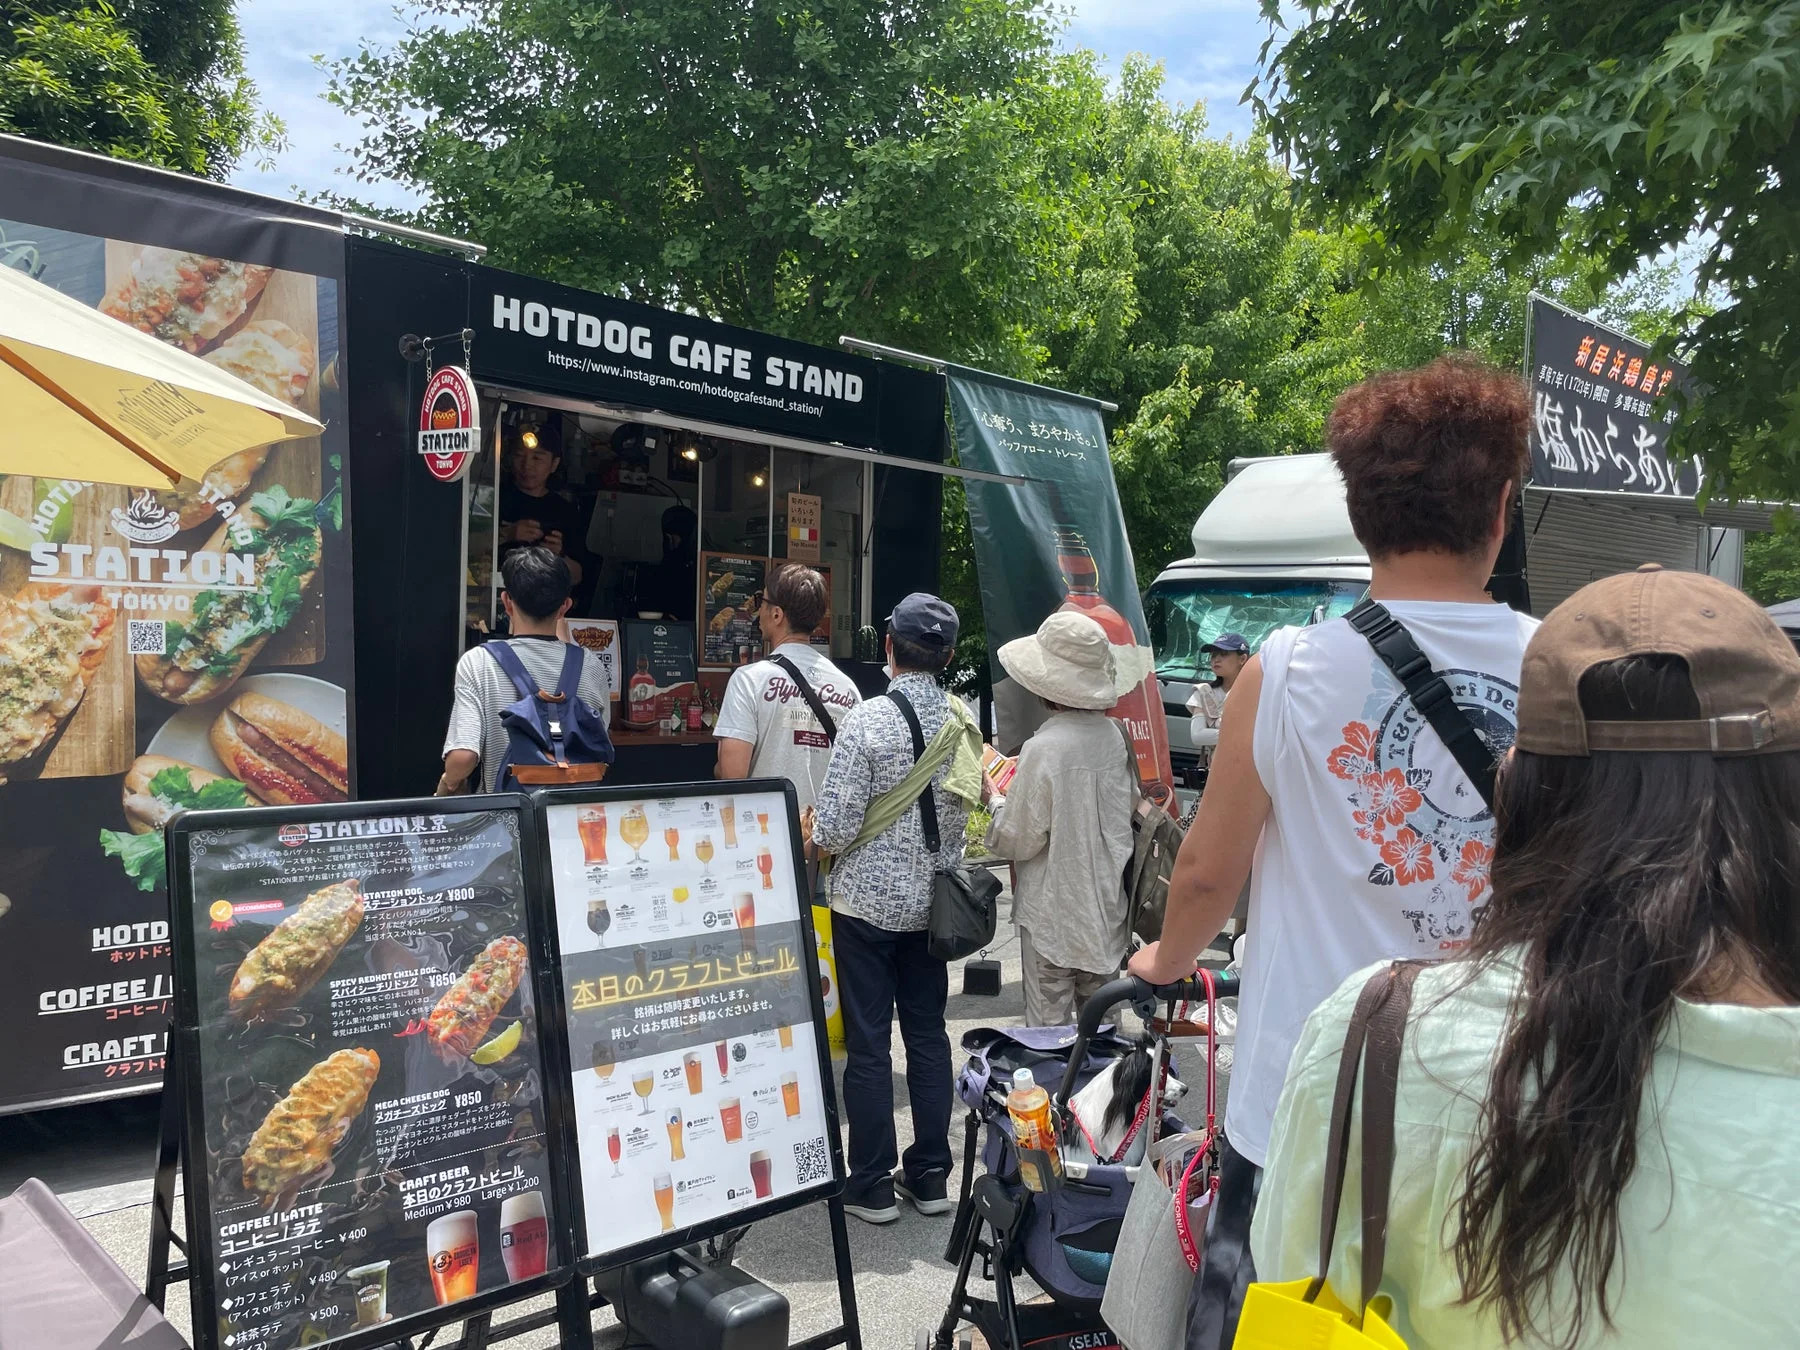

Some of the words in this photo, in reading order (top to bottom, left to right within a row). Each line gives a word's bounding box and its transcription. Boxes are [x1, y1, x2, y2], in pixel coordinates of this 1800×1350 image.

[494, 295, 652, 360] HOTDOG
[669, 335, 751, 381] CAFE
[766, 356, 863, 403] STAND
[441, 374, 454, 385] CAFE
[548, 350, 824, 417] https://www.instagram.com/hotdogcafestand_station/
[422, 431, 469, 451] STATION
[436, 459, 453, 469] TOKYO
[30, 542, 255, 585] STATION
[108, 592, 189, 611] TOKYO
[309, 815, 447, 839] STATION東京
[363, 892, 444, 910] ステーションドッグ
[364, 889, 403, 900] STATION
[405, 887, 423, 896] DOG
[447, 887, 475, 902] ¥800
[92, 920, 168, 948] HOTD
[330, 979, 356, 989] SPICY
[358, 973, 392, 985] REDHOT
[393, 969, 419, 979] CHILI
[420, 967, 437, 975] DOG
[331, 977, 418, 997] スパイシーチリドッグ
[429, 972, 457, 987] ¥850
[572, 947, 796, 1007] 本日のクラフトビール
[39, 979, 147, 1011] COFFEE
[634, 988, 750, 1019] 銘柄は随時変更いたします。
[611, 1000, 773, 1040] 詳しくはお気軽にお尋ねくださいませ。
[63, 1033, 157, 1065] CRAFT
[374, 1099, 399, 1111] MEGA
[400, 1092, 432, 1105] CHEESE
[433, 1088, 451, 1098] DOG
[375, 1099, 447, 1121] メガチーズドッグ
[454, 1090, 482, 1108] ¥850
[399, 1173, 438, 1192] CRAFT
[439, 1165, 470, 1181] BEER
[402, 1164, 525, 1206] 本日のクラフトビール
[220, 1215, 271, 1238] COFFEE
[280, 1202, 323, 1222] LATTE
[339, 1227, 367, 1243] ¥400
[309, 1270, 337, 1286] ¥480
[234, 1282, 292, 1308] カフェラテ
[310, 1305, 339, 1322] ¥500
[236, 1321, 283, 1344] 抹茶ラテ
